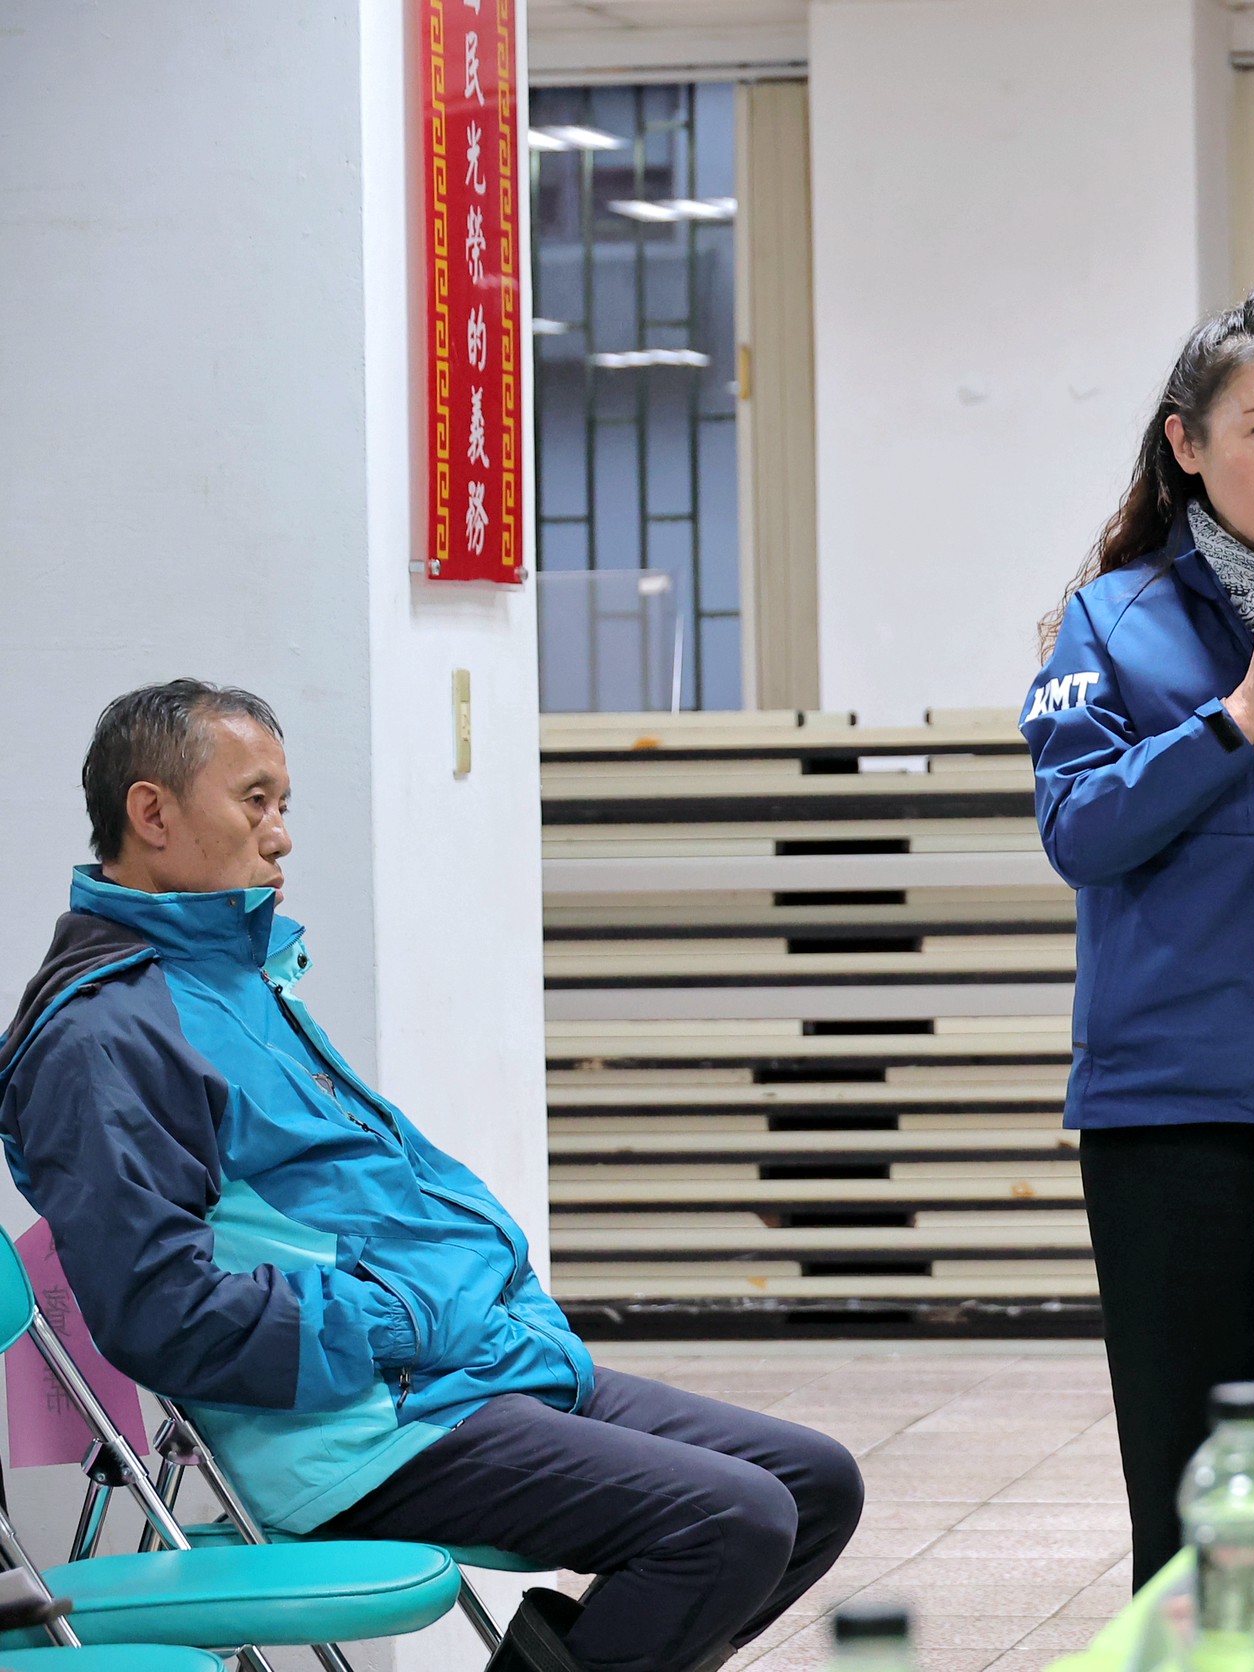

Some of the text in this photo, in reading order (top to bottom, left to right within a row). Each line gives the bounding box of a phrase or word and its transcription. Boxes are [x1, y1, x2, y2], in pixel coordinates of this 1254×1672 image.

[464, 0, 490, 557] 民光榮的義務
[1024, 671, 1100, 723] KMT
